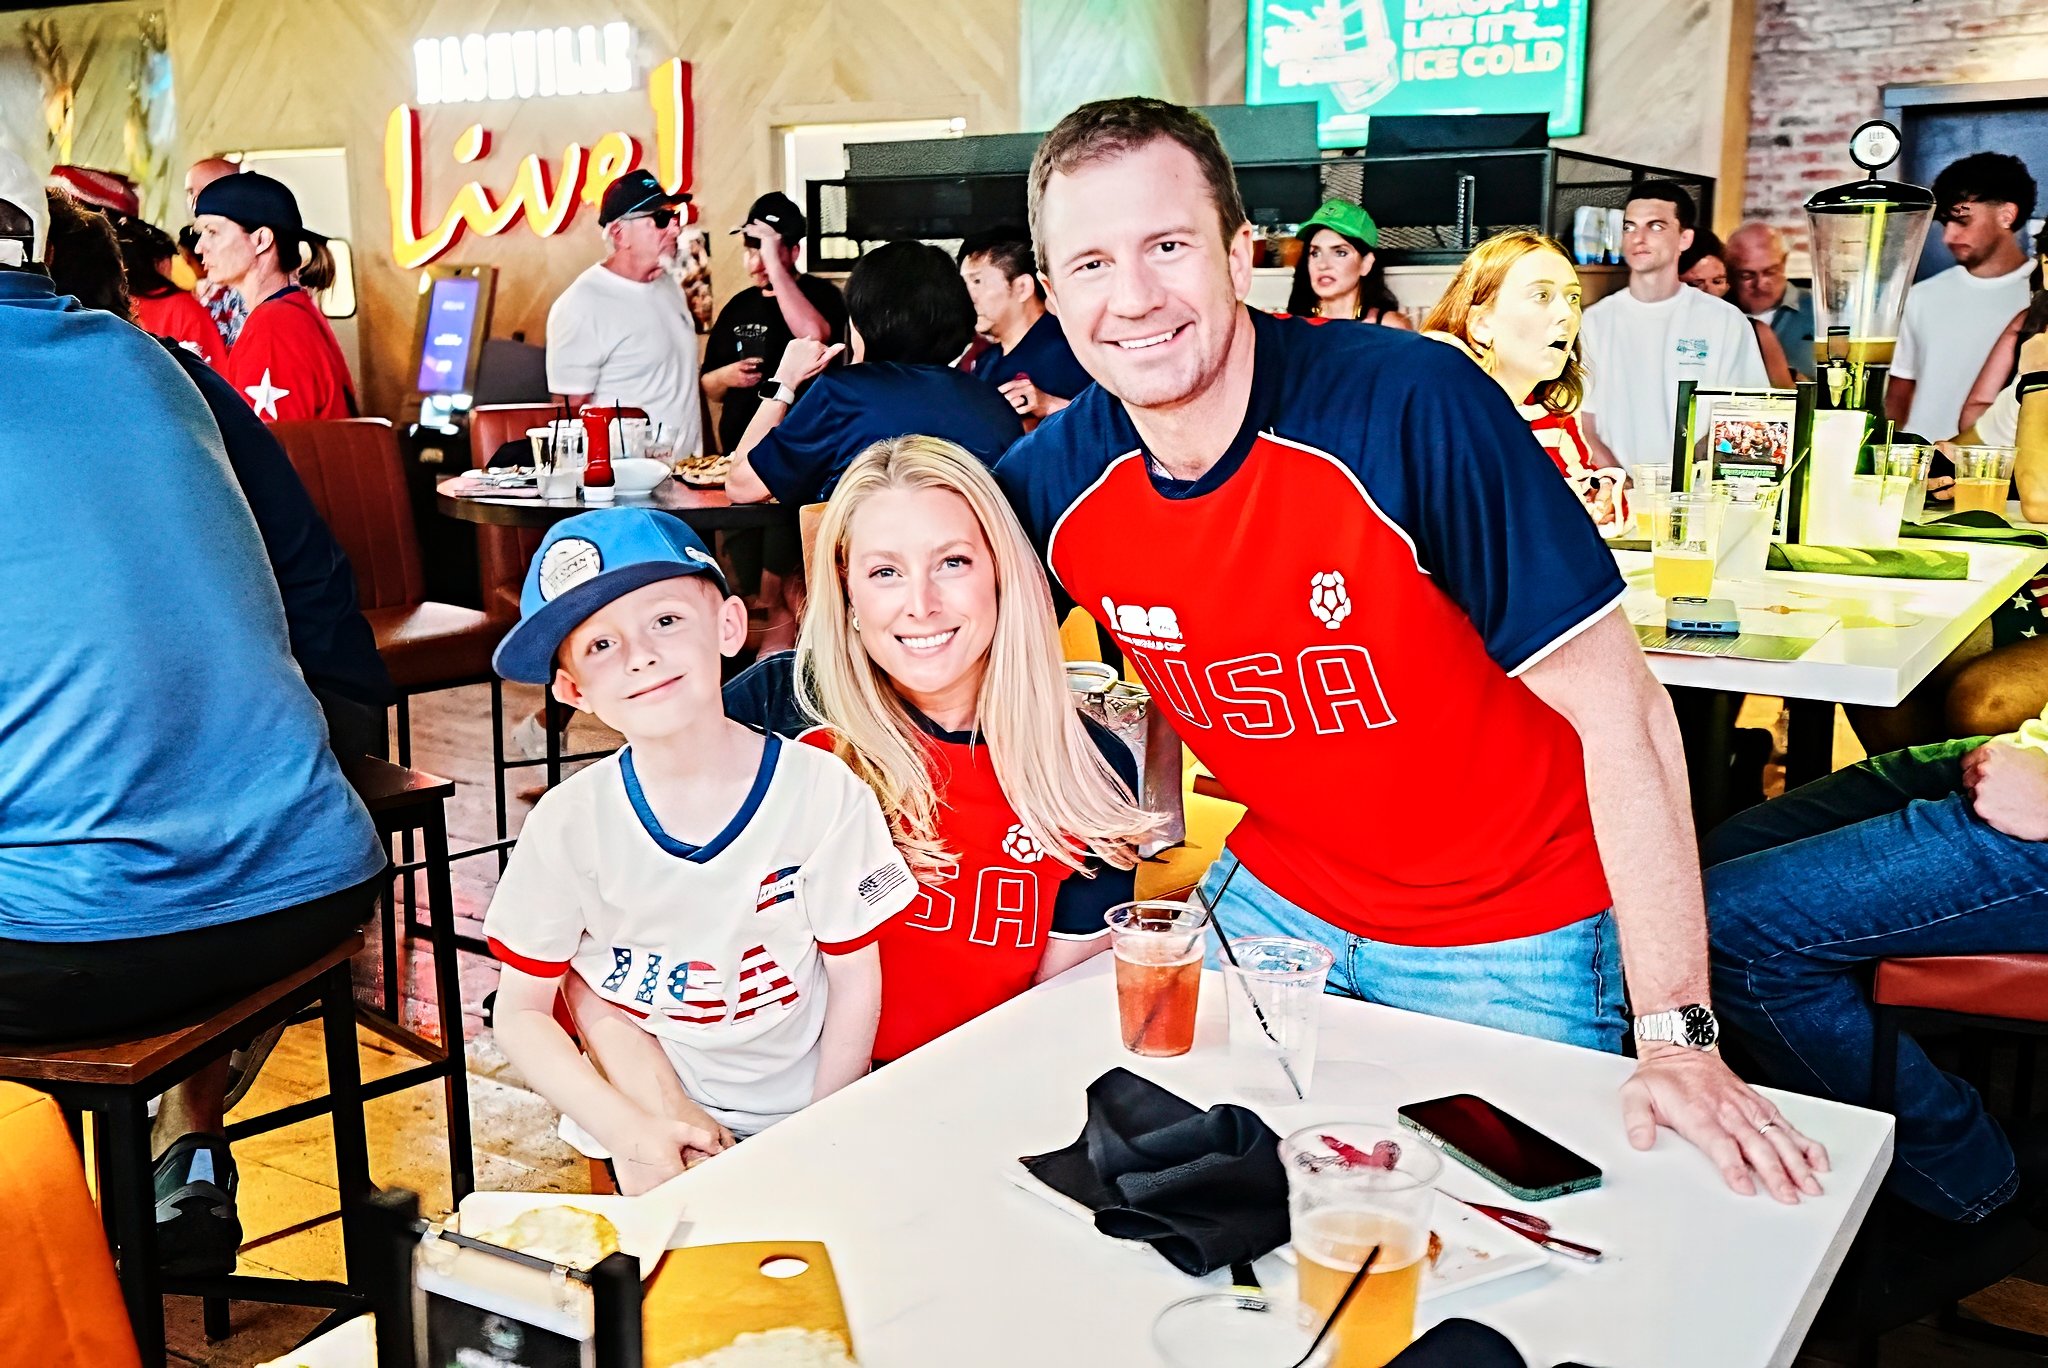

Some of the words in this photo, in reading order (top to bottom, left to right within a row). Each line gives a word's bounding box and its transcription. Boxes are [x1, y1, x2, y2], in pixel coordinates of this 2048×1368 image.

[1402, 48, 1460, 82] ICE
[1462, 40, 1564, 78] COLD
[385, 57, 695, 269] Live!
[1131, 644, 1398, 739] USA
